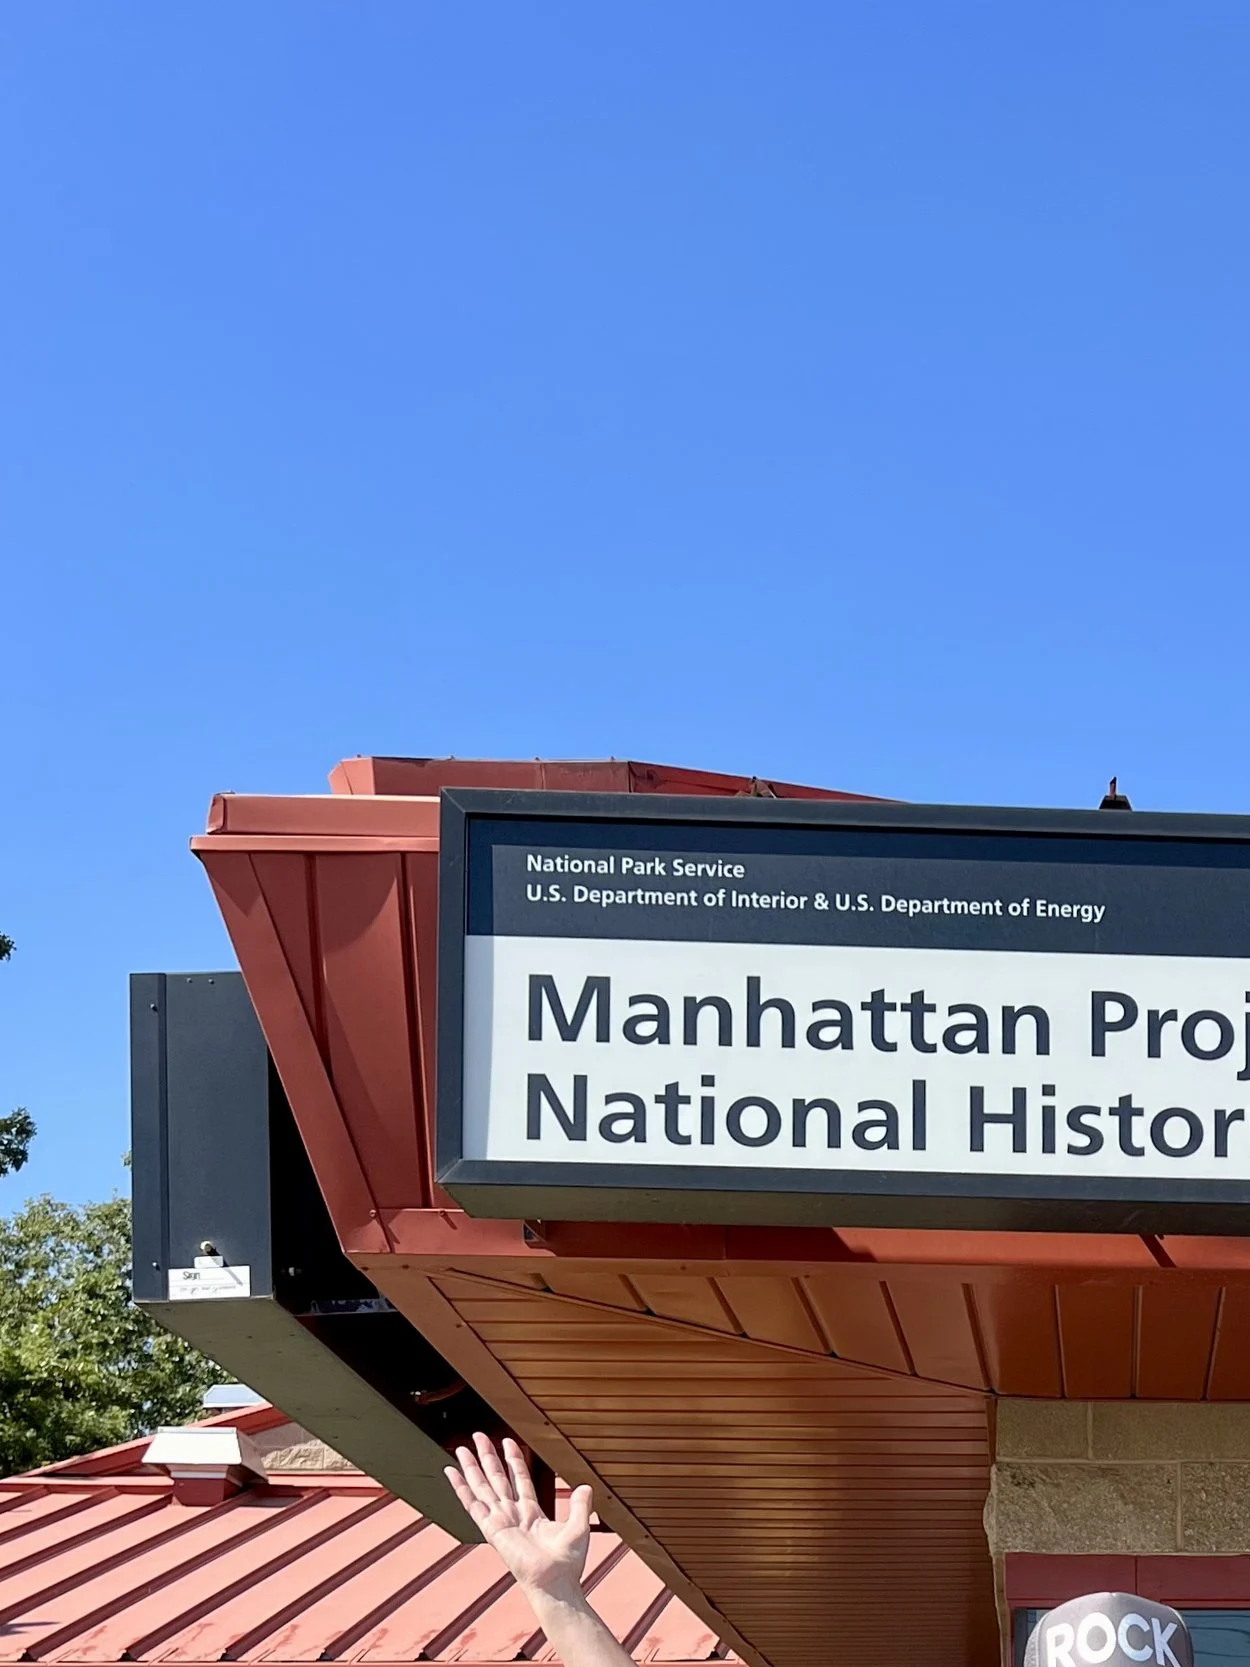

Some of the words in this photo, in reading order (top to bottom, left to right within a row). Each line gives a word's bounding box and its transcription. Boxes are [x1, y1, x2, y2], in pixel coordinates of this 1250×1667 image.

[526, 854, 615, 875] National
[621, 857, 667, 877] Park
[673, 859, 746, 879] Service
[526, 884, 567, 903] U.S.
[573, 885, 698, 908] Department
[703, 888, 727, 907] of
[731, 890, 808, 910] Interior
[813, 893, 830, 911] &
[835, 893, 874, 912] U.S.
[881, 894, 1003, 917] Department
[1008, 898, 1030, 917] of
[1036, 900, 1106, 923] Energy
[527, 973, 1050, 1057] Manhattan
[526, 1073, 927, 1151] National
